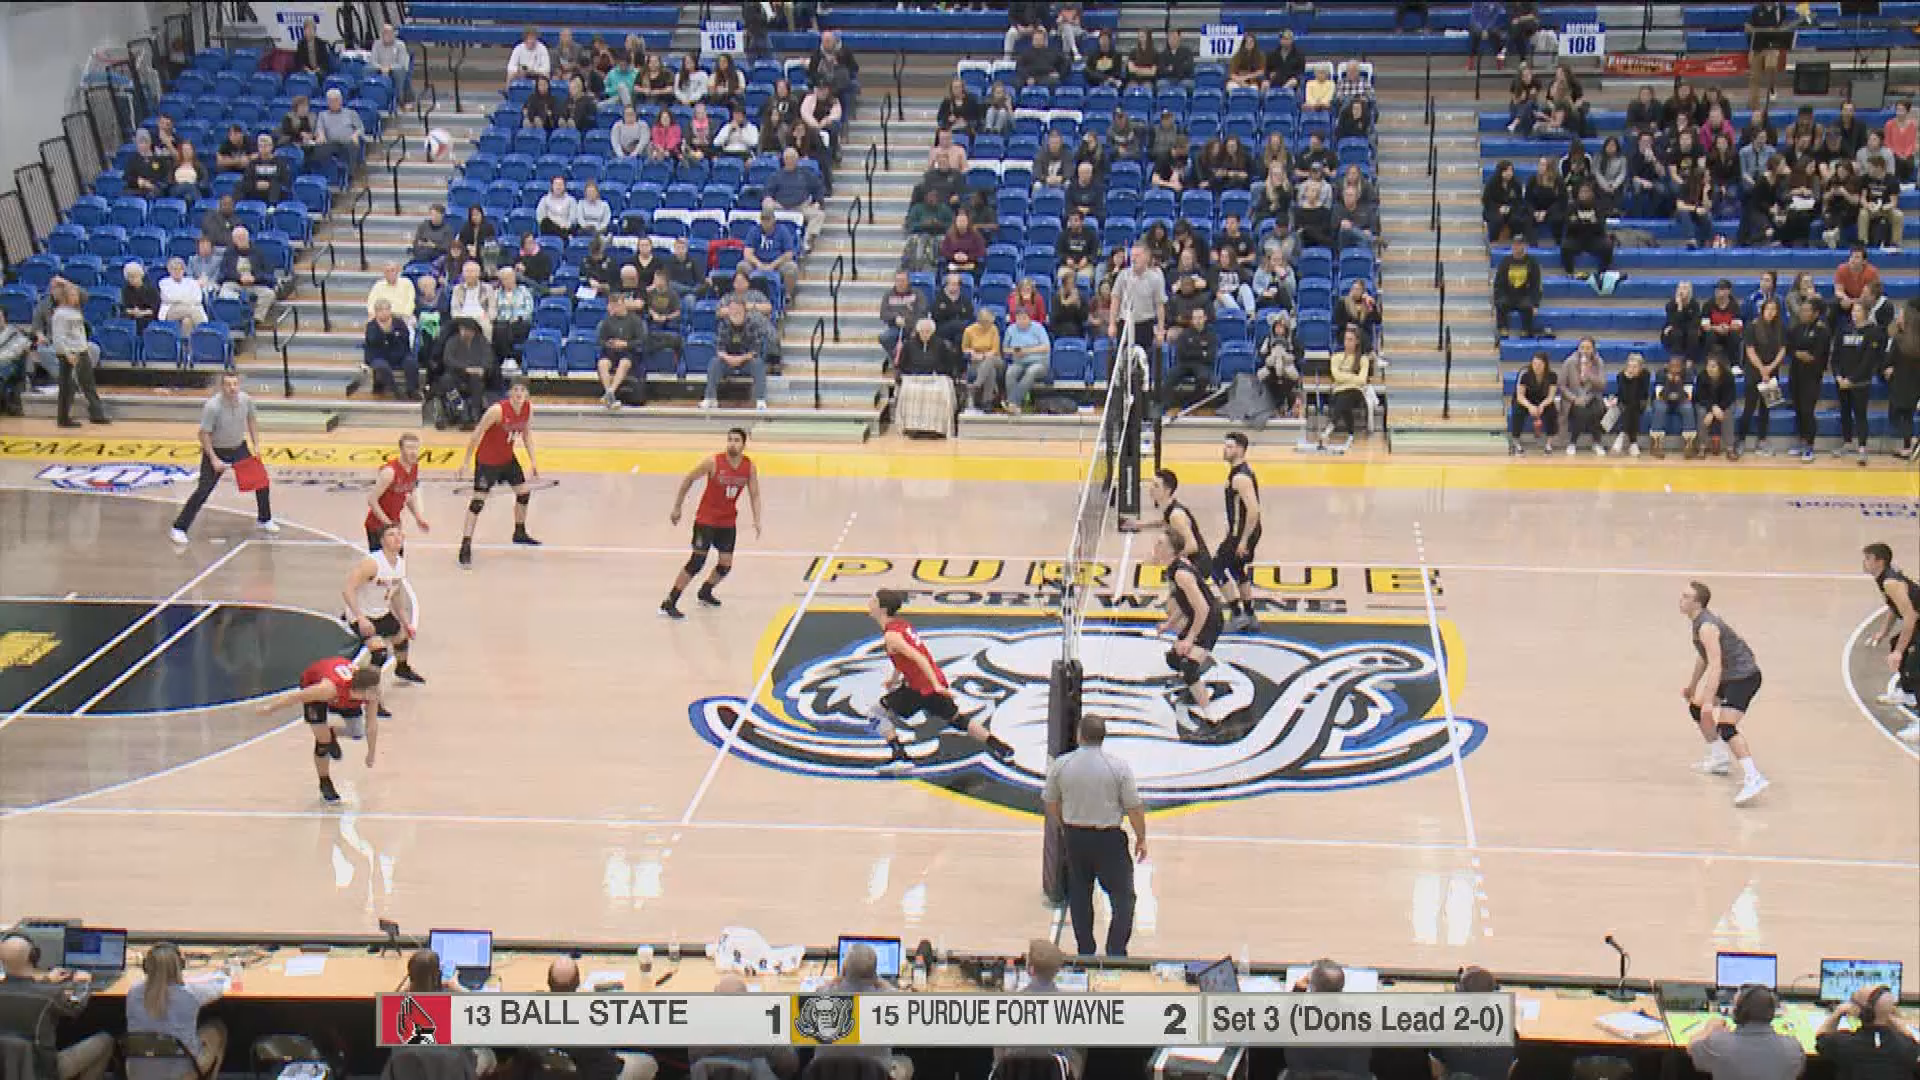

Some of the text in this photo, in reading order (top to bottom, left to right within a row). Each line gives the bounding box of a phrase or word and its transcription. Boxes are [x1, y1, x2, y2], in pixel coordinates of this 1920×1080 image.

[710, 34, 736, 50] 106
[1210, 38, 1234, 54] 107
[1569, 36, 1596, 54] 108
